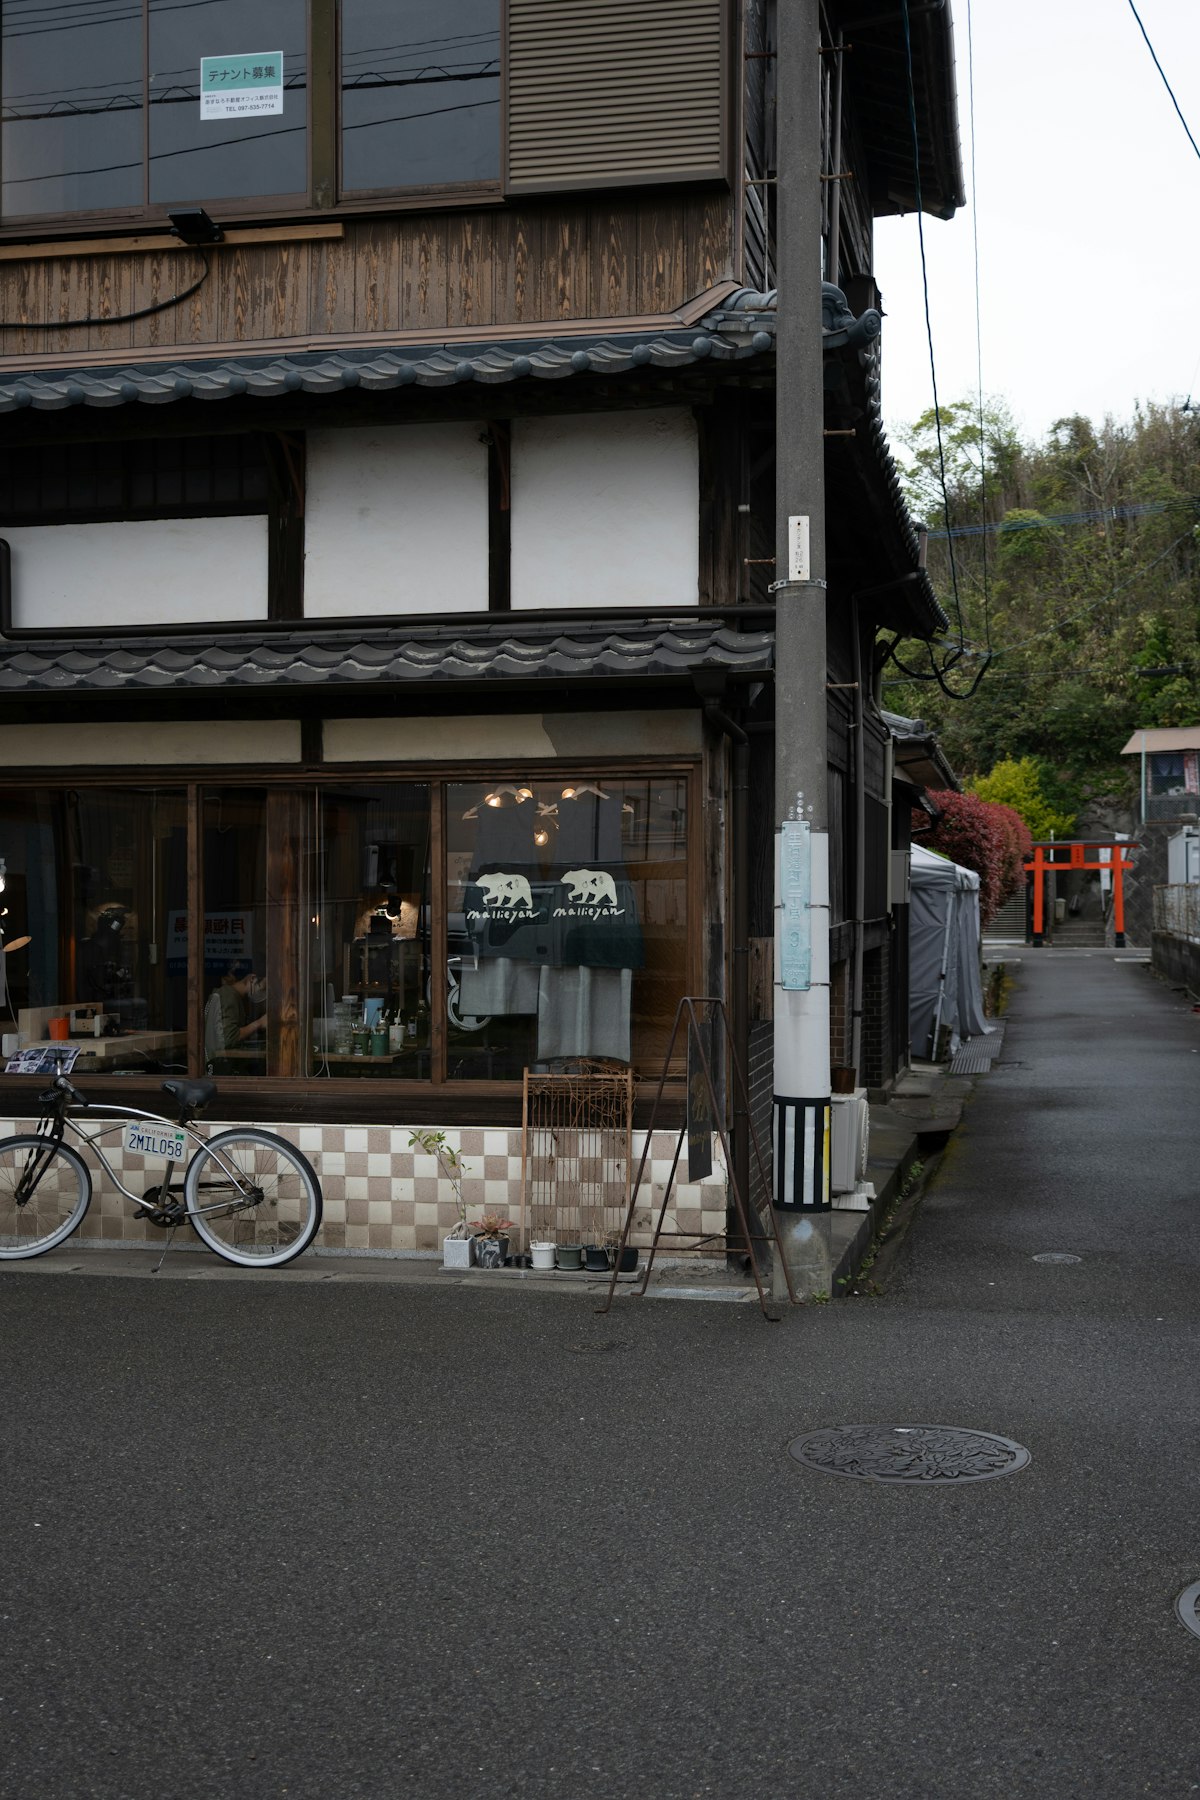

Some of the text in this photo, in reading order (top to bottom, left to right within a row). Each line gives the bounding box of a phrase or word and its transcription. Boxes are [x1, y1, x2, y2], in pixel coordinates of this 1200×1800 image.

[209, 66, 275, 81] テナント募集
[141, 1127, 173, 1137] CALIFORNIA
